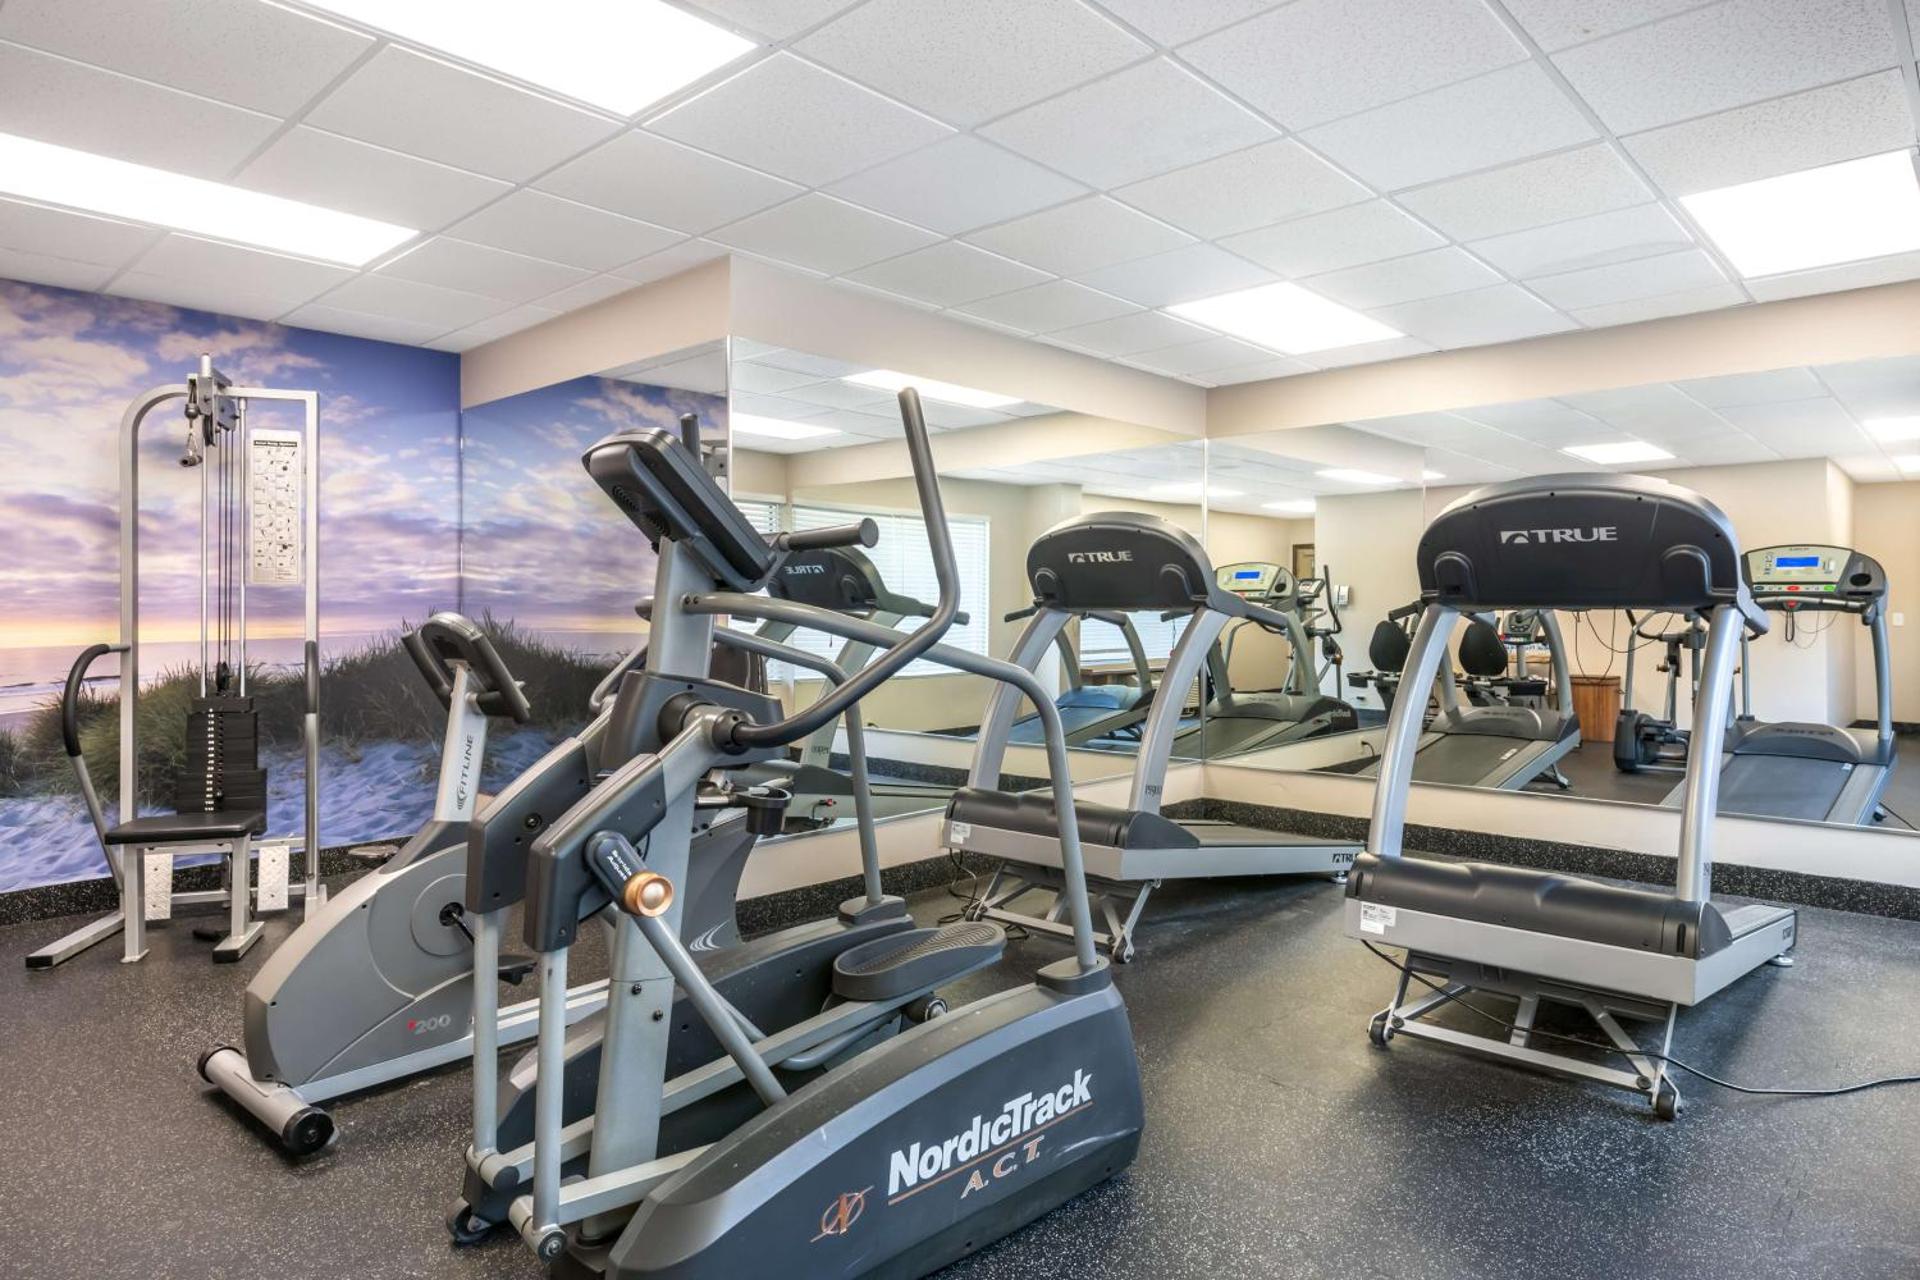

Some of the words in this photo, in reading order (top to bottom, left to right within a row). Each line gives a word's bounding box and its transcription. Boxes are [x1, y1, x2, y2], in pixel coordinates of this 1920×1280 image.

[1530, 526, 1618, 543] TRUE
[1084, 549, 1134, 563] TRUE
[460, 734, 474, 796] FITLINE
[887, 1068, 1093, 1196] NordicTrack
